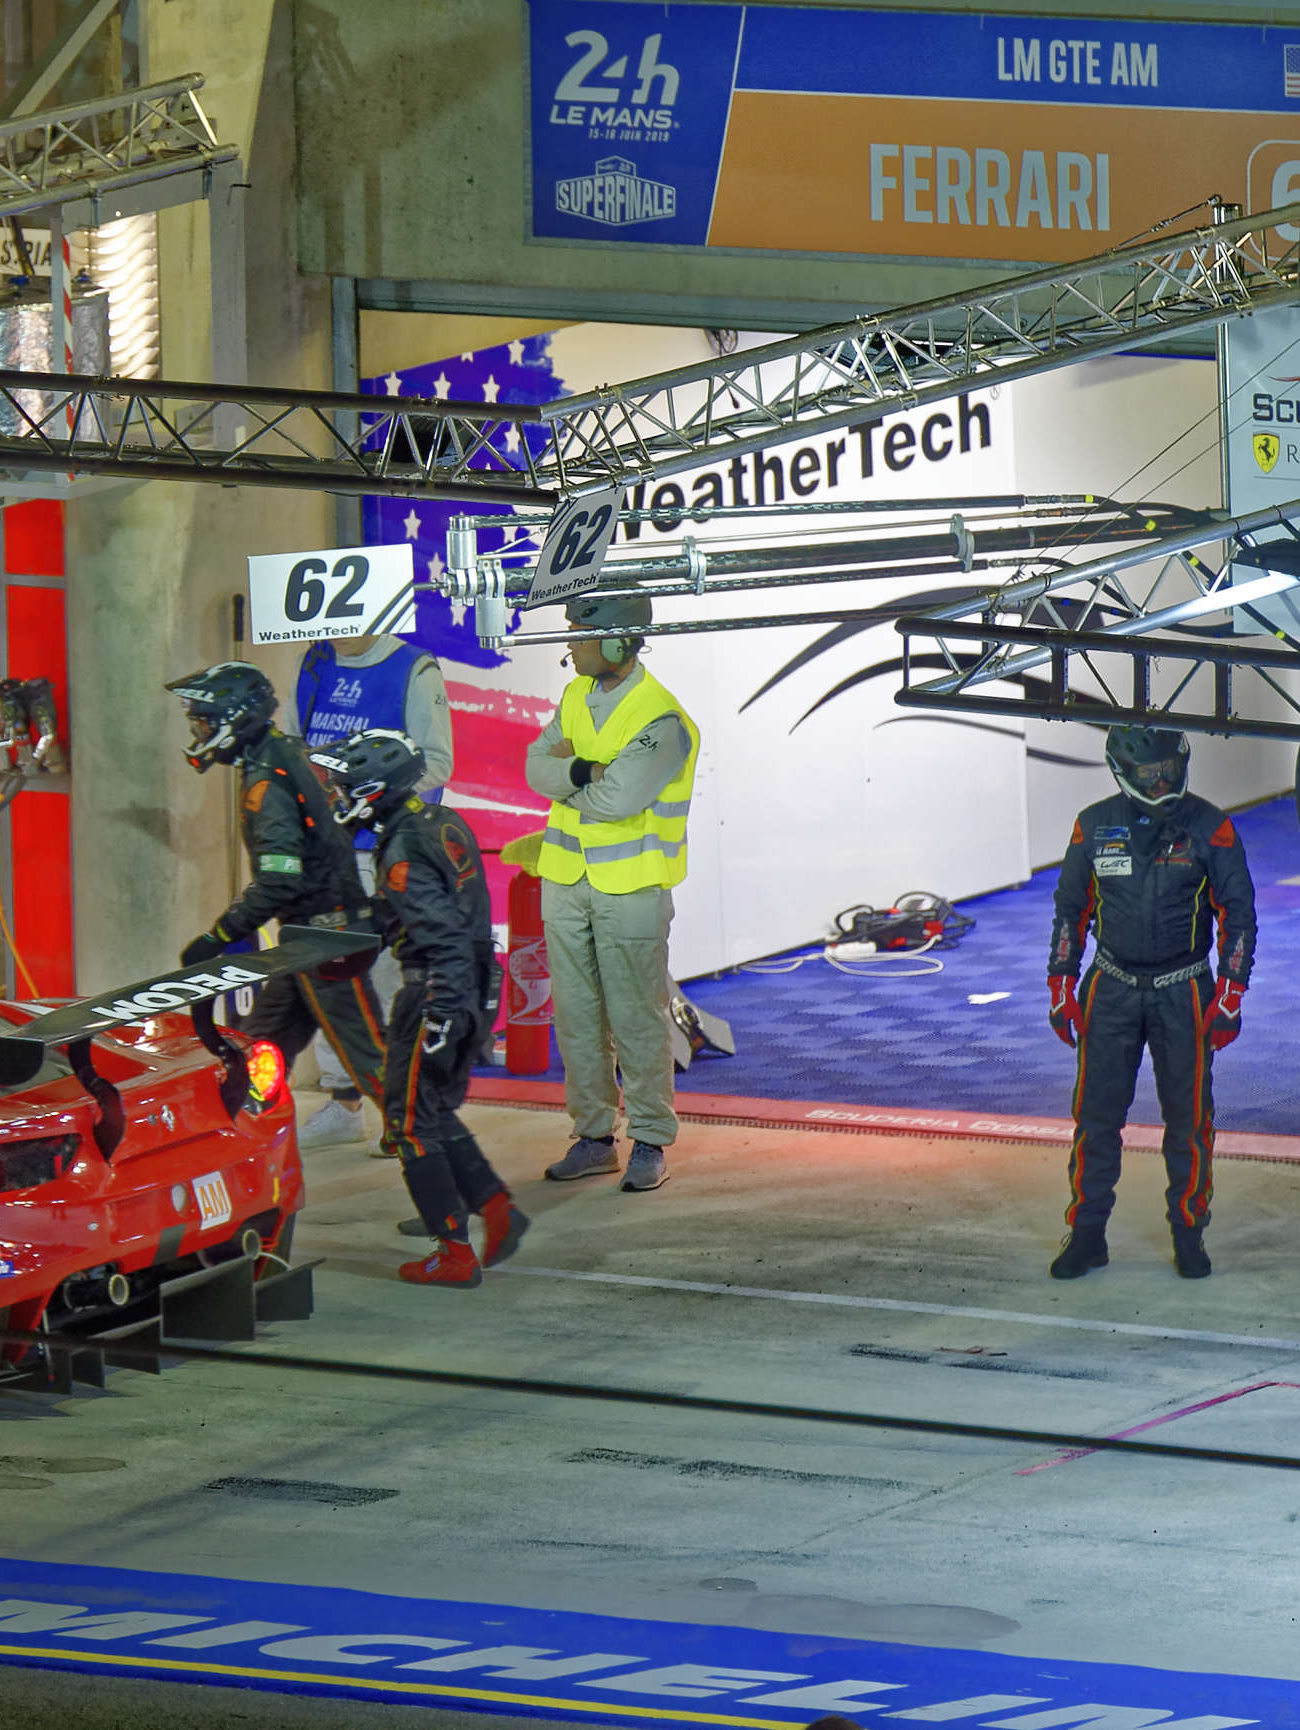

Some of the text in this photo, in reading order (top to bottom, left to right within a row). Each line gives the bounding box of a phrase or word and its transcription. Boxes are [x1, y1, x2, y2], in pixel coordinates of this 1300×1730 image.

[554, 30, 680, 106] 24h
[998, 37, 1159, 88] LM GTE AM
[550, 104, 673, 129] LE MANS
[557, 174, 674, 223] SUPERFINALE
[869, 143, 1110, 231] FERRARI
[1252, 392, 1300, 424] SC
[611, 394, 992, 545] WeatherTech
[549, 503, 613, 576] 62
[284, 554, 370, 622] 62
[531, 574, 597, 601] WeatherTech
[258, 624, 361, 641] WeatherTech
[91, 965, 269, 1022] PECOM
[805, 1109, 1074, 1138] SCUDERIA CORSA
[198, 1180, 230, 1221] AM
